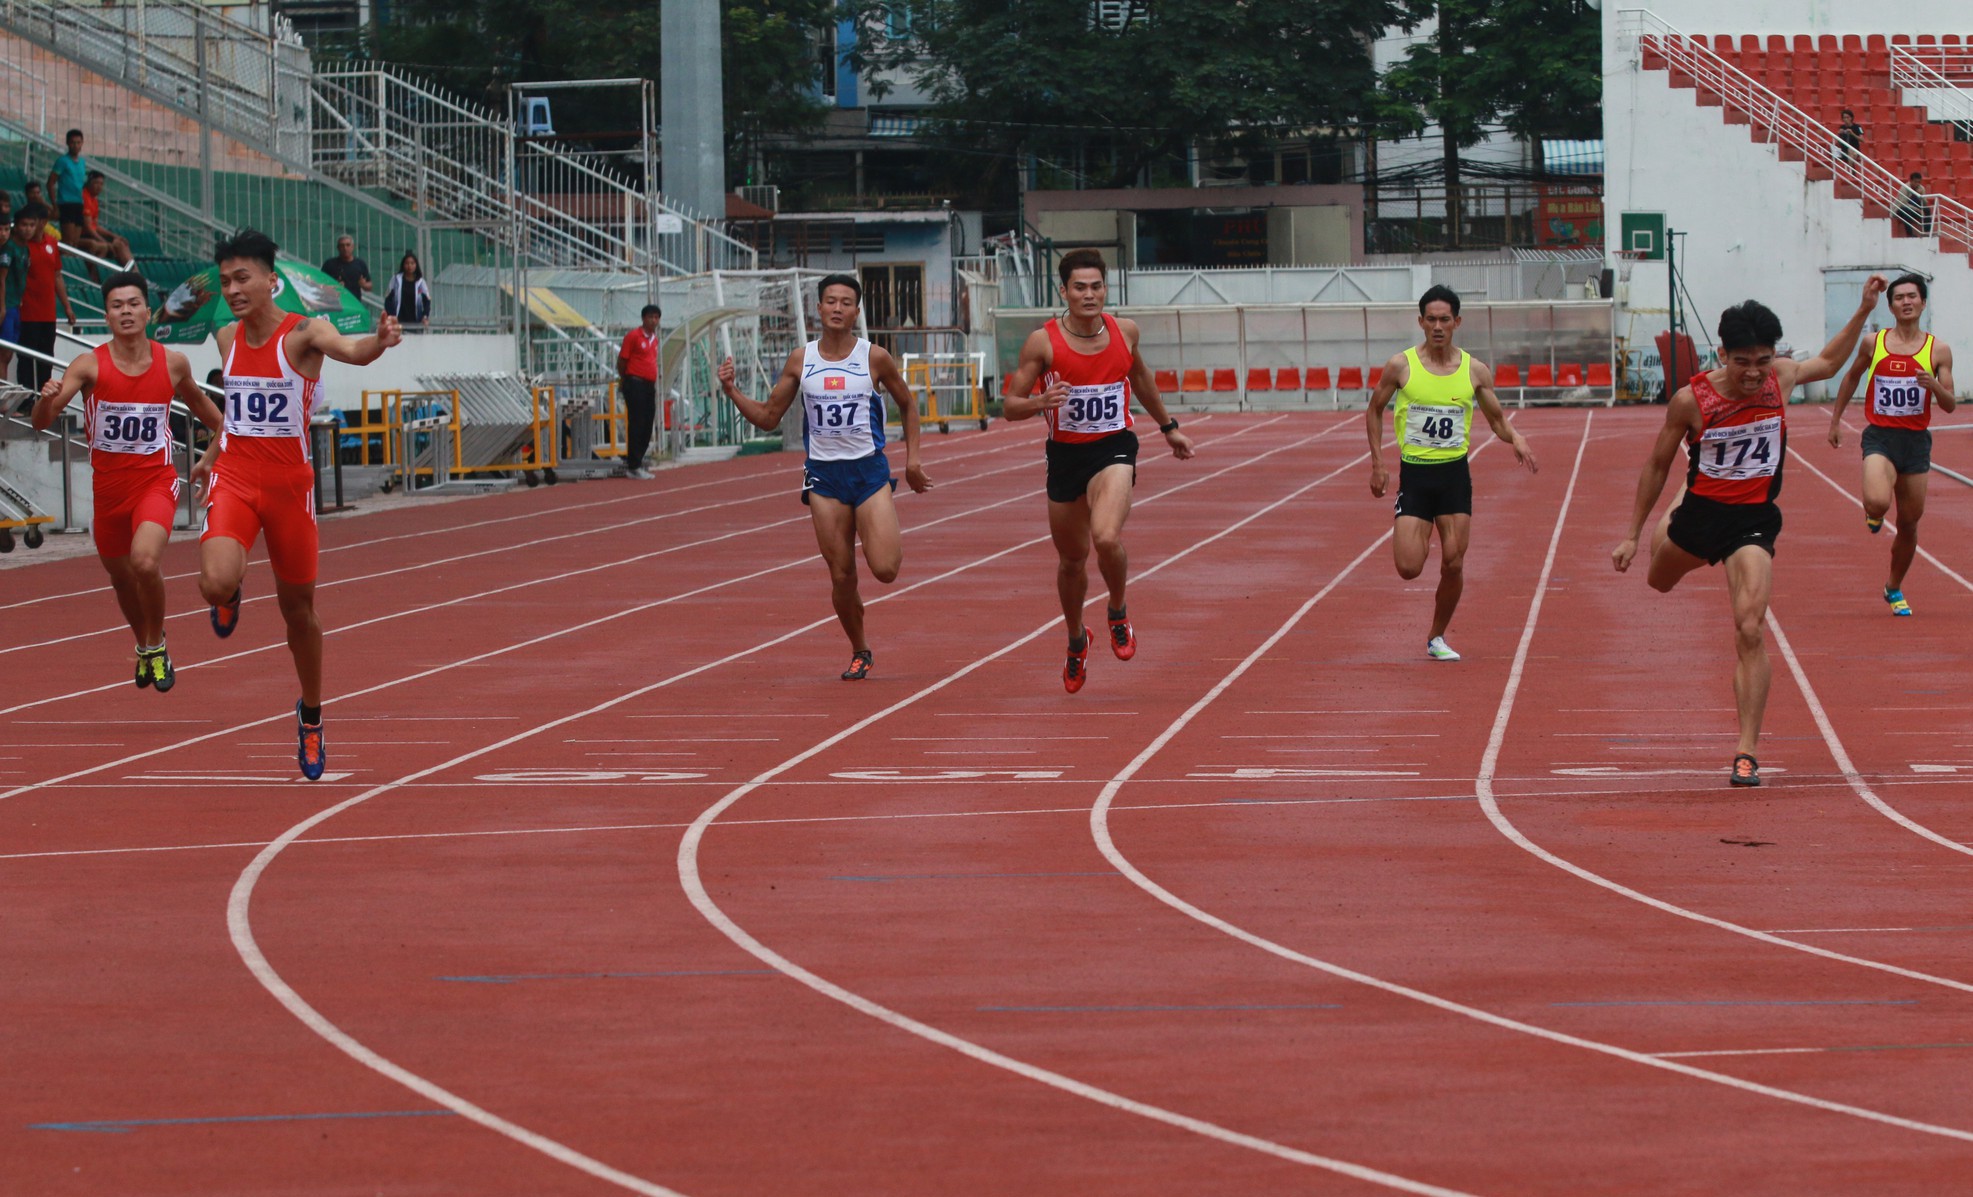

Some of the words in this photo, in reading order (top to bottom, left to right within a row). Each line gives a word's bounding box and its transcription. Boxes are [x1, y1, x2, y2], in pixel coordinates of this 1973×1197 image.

[230, 393, 288, 422] 192
[1069, 395, 1117, 421] 305
[1879, 387, 1919, 407] 309
[814, 403, 858, 426] 137
[104, 415, 157, 442] 308
[1422, 417, 1453, 439] 48
[1712, 437, 1770, 466] 174
